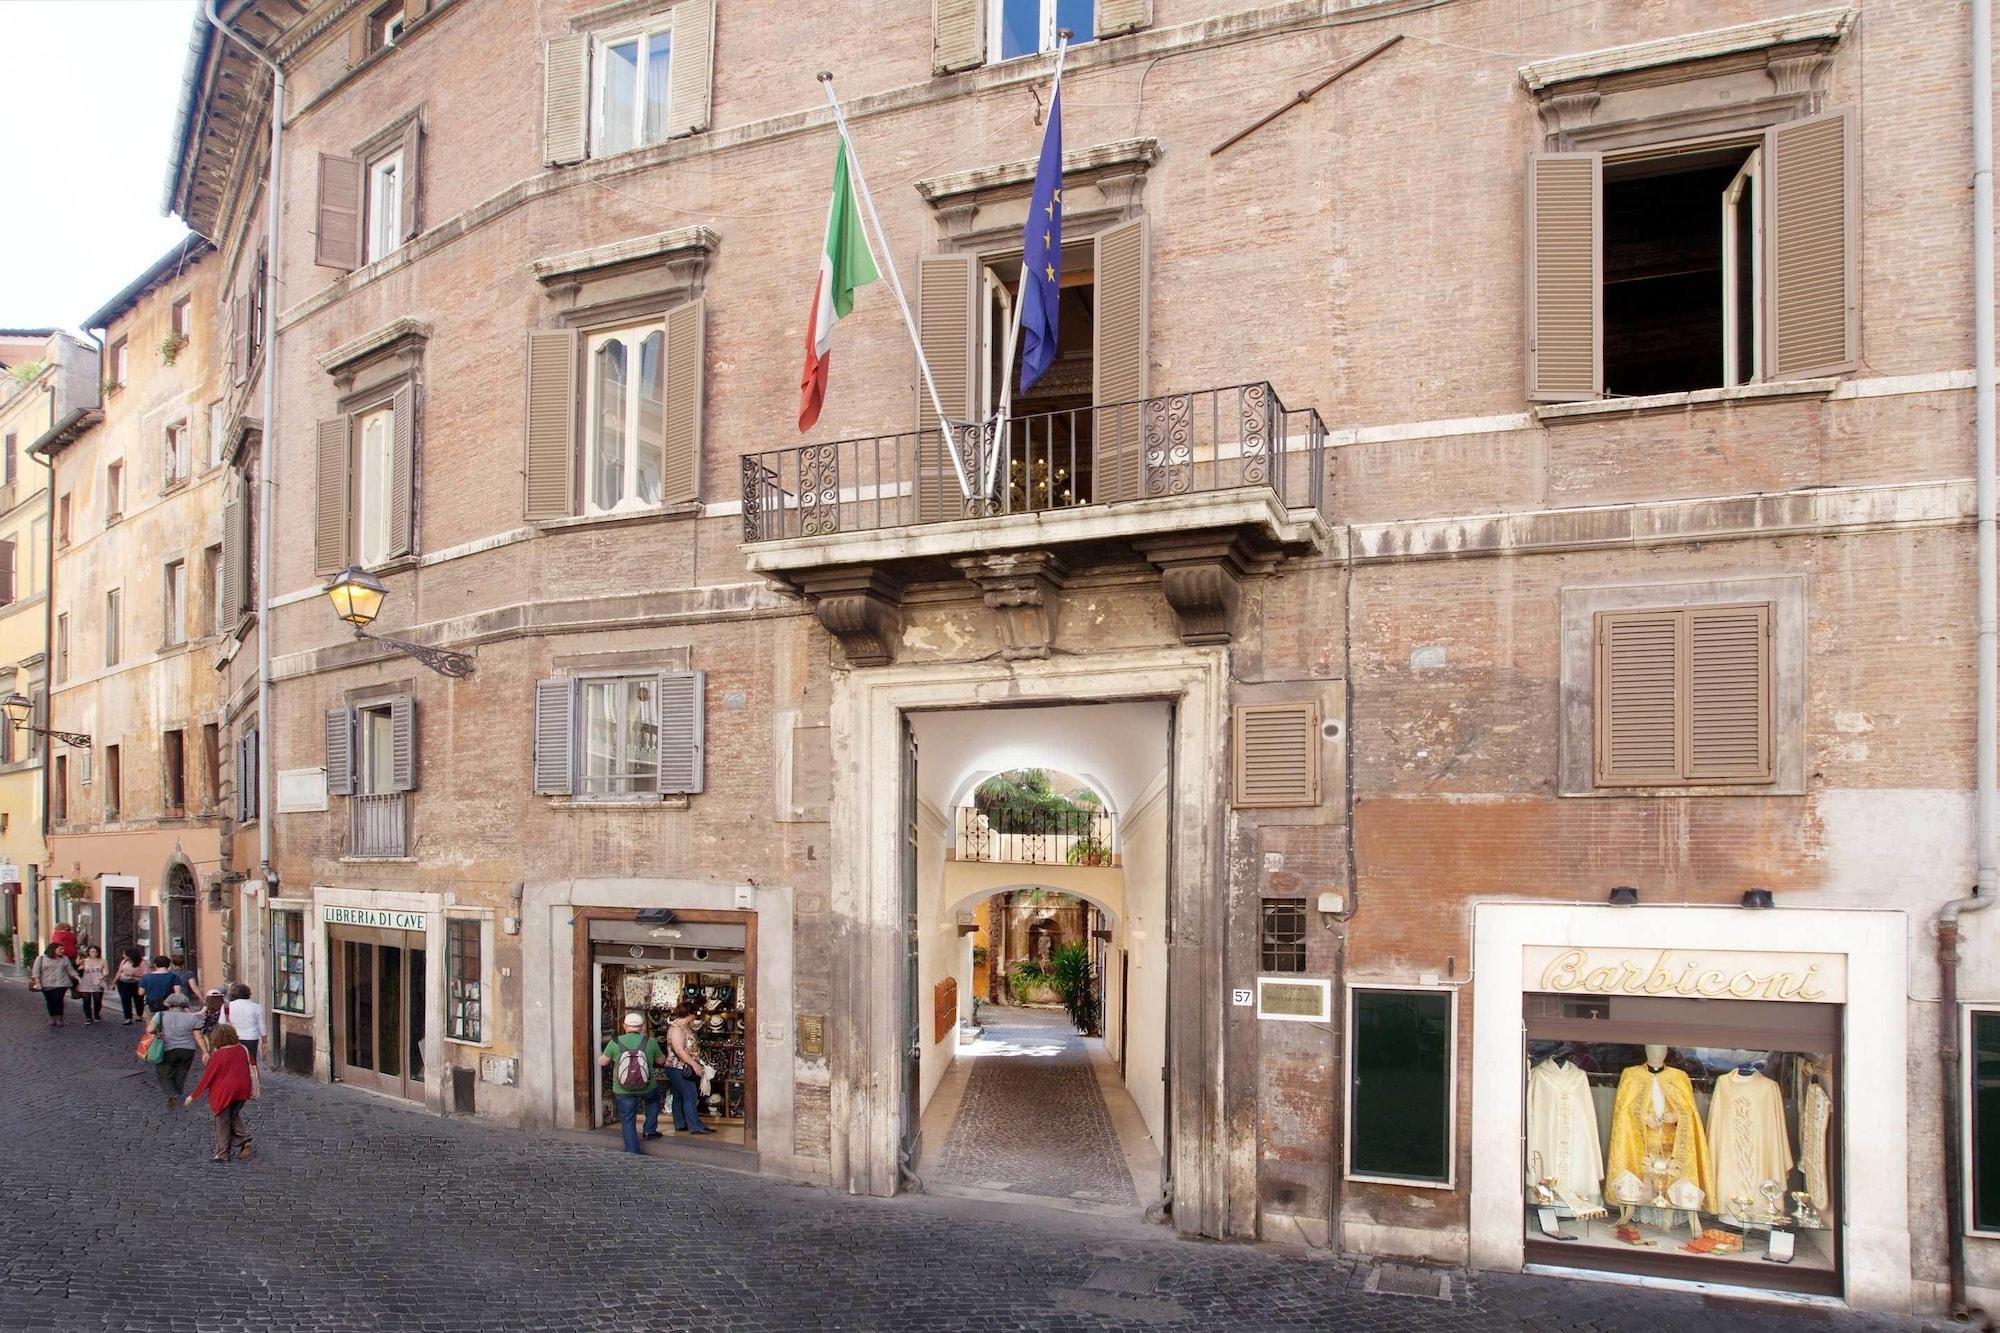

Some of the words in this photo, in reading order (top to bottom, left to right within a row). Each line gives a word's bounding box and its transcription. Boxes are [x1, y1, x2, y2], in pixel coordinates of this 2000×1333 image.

[325, 908, 375, 925] LIBRERIA
[379, 912, 391, 926] DI
[396, 914, 424, 929] CAVE
[1540, 948, 1825, 1000] Barbiconi
[1234, 991, 1251, 1003] 57
